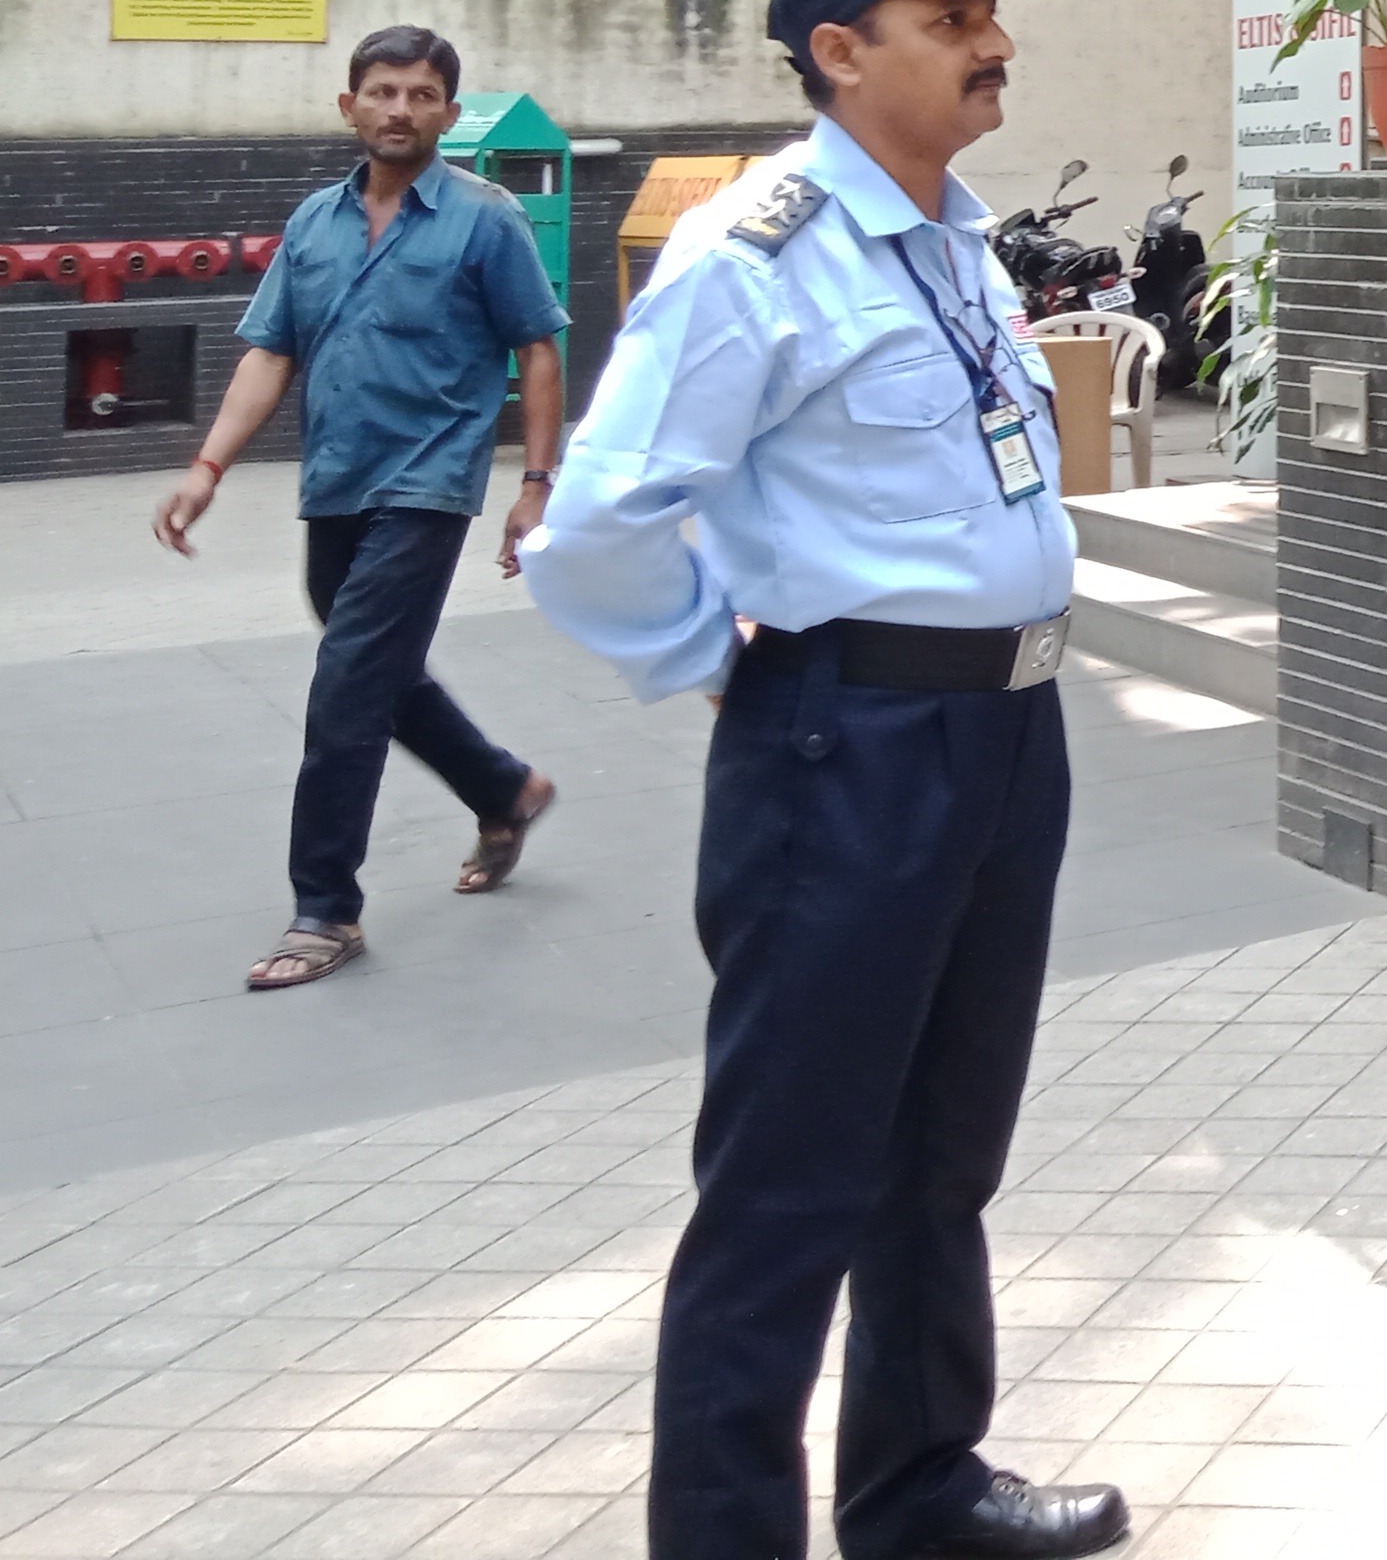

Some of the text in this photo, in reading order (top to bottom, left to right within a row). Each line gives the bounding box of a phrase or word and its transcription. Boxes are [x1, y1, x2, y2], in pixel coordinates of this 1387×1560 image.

[1237, 13, 1283, 50] ELTIS
[1303, 121, 1332, 144] Office
[1095, 292, 1130, 309] 6950
